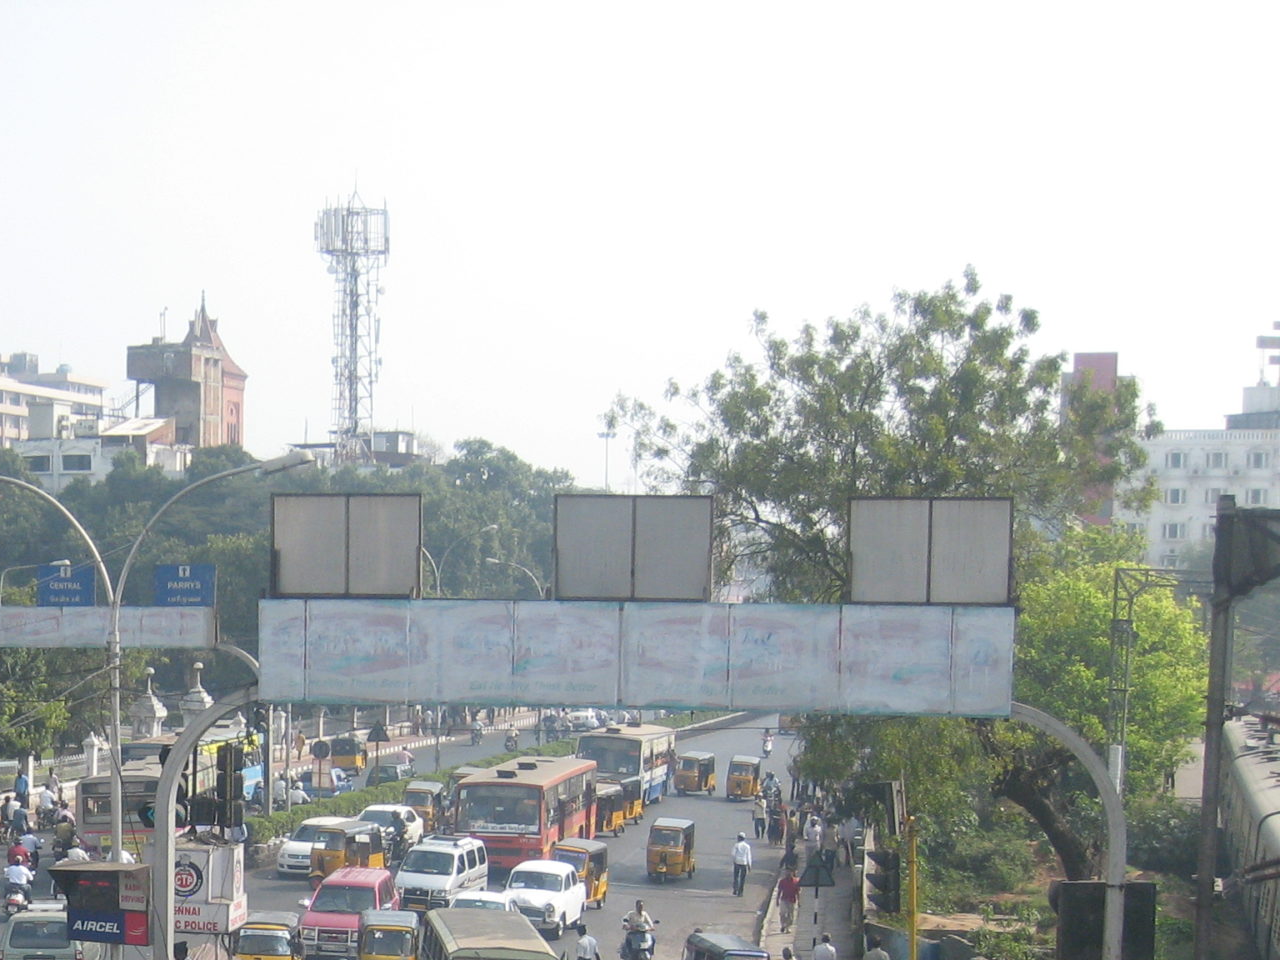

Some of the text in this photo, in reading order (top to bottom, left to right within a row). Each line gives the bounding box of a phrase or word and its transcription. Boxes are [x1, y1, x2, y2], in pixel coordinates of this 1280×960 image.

[49, 582, 81, 590] CENTRAL
[72, 920, 120, 933] AIRCEL
[184, 920, 219, 931] POLICE
